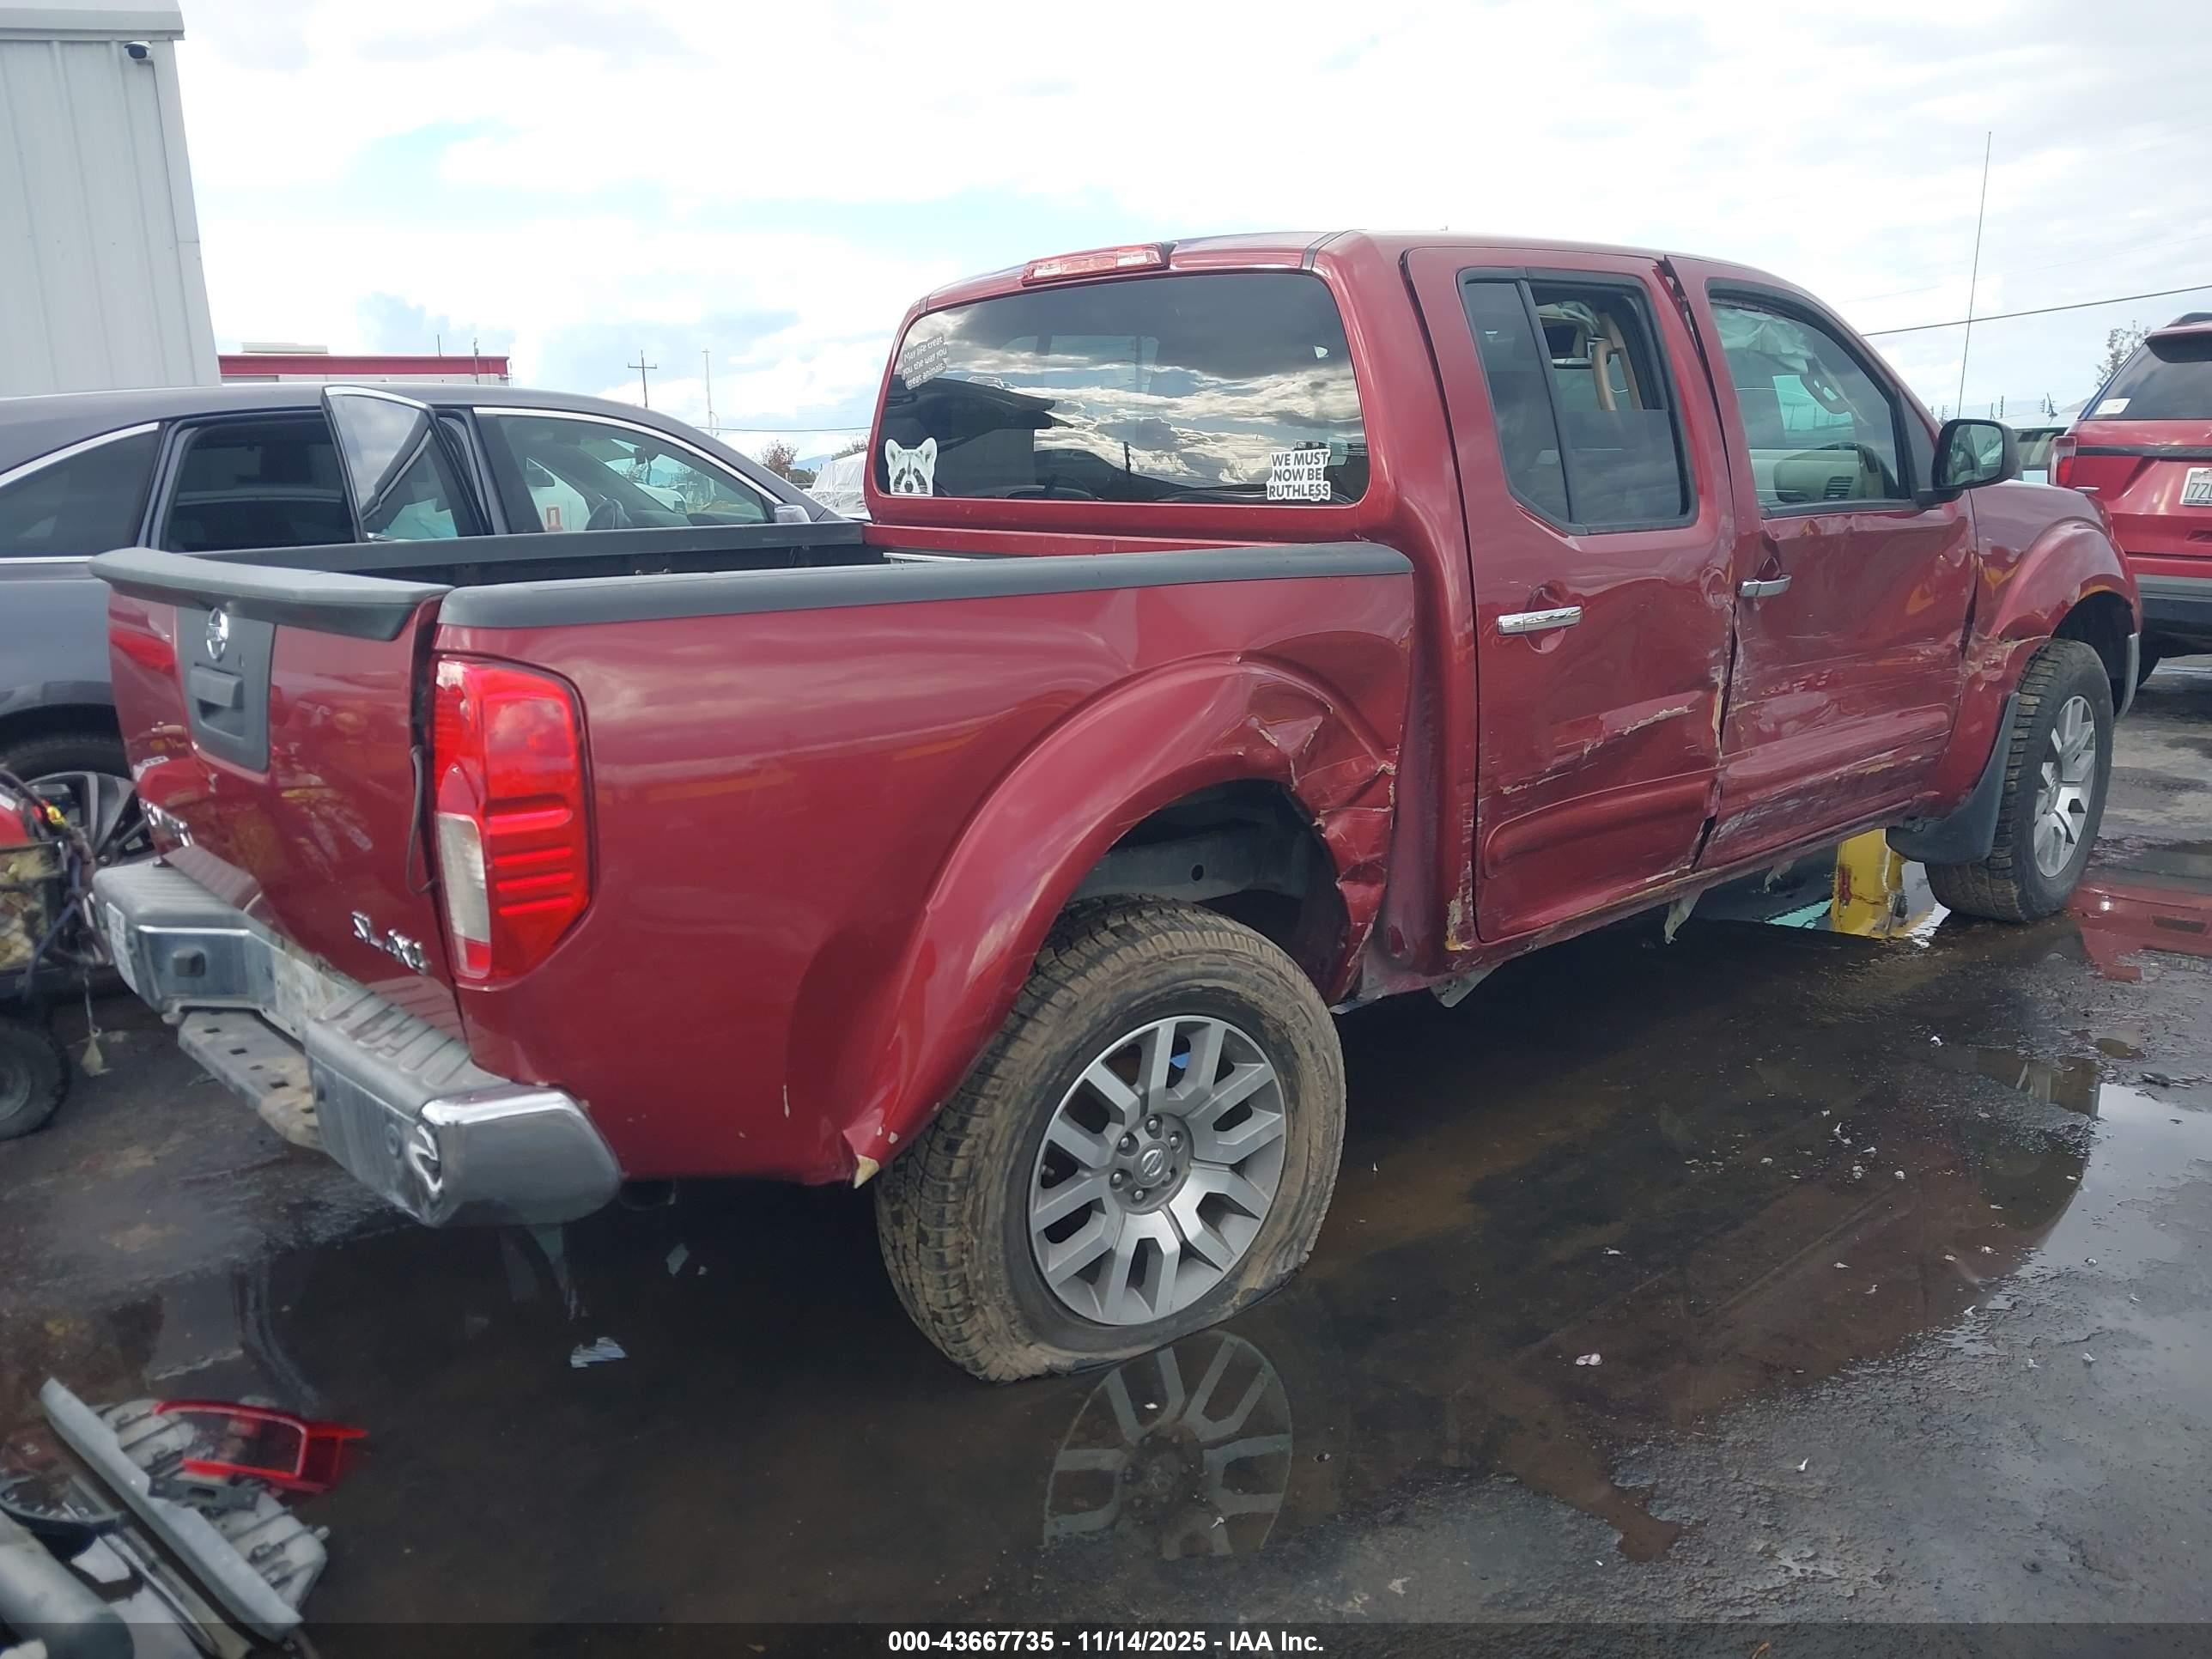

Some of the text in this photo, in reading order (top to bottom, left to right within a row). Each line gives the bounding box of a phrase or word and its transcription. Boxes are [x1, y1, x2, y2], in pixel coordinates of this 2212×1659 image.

[916, 345, 927, 356] life
[913, 361, 924, 370] the
[907, 374, 922, 386] treat
[1271, 451, 1329, 467] WE MUST
[1273, 467, 1322, 482] NOW BE
[1268, 483, 1329, 498] RUTHLESS
